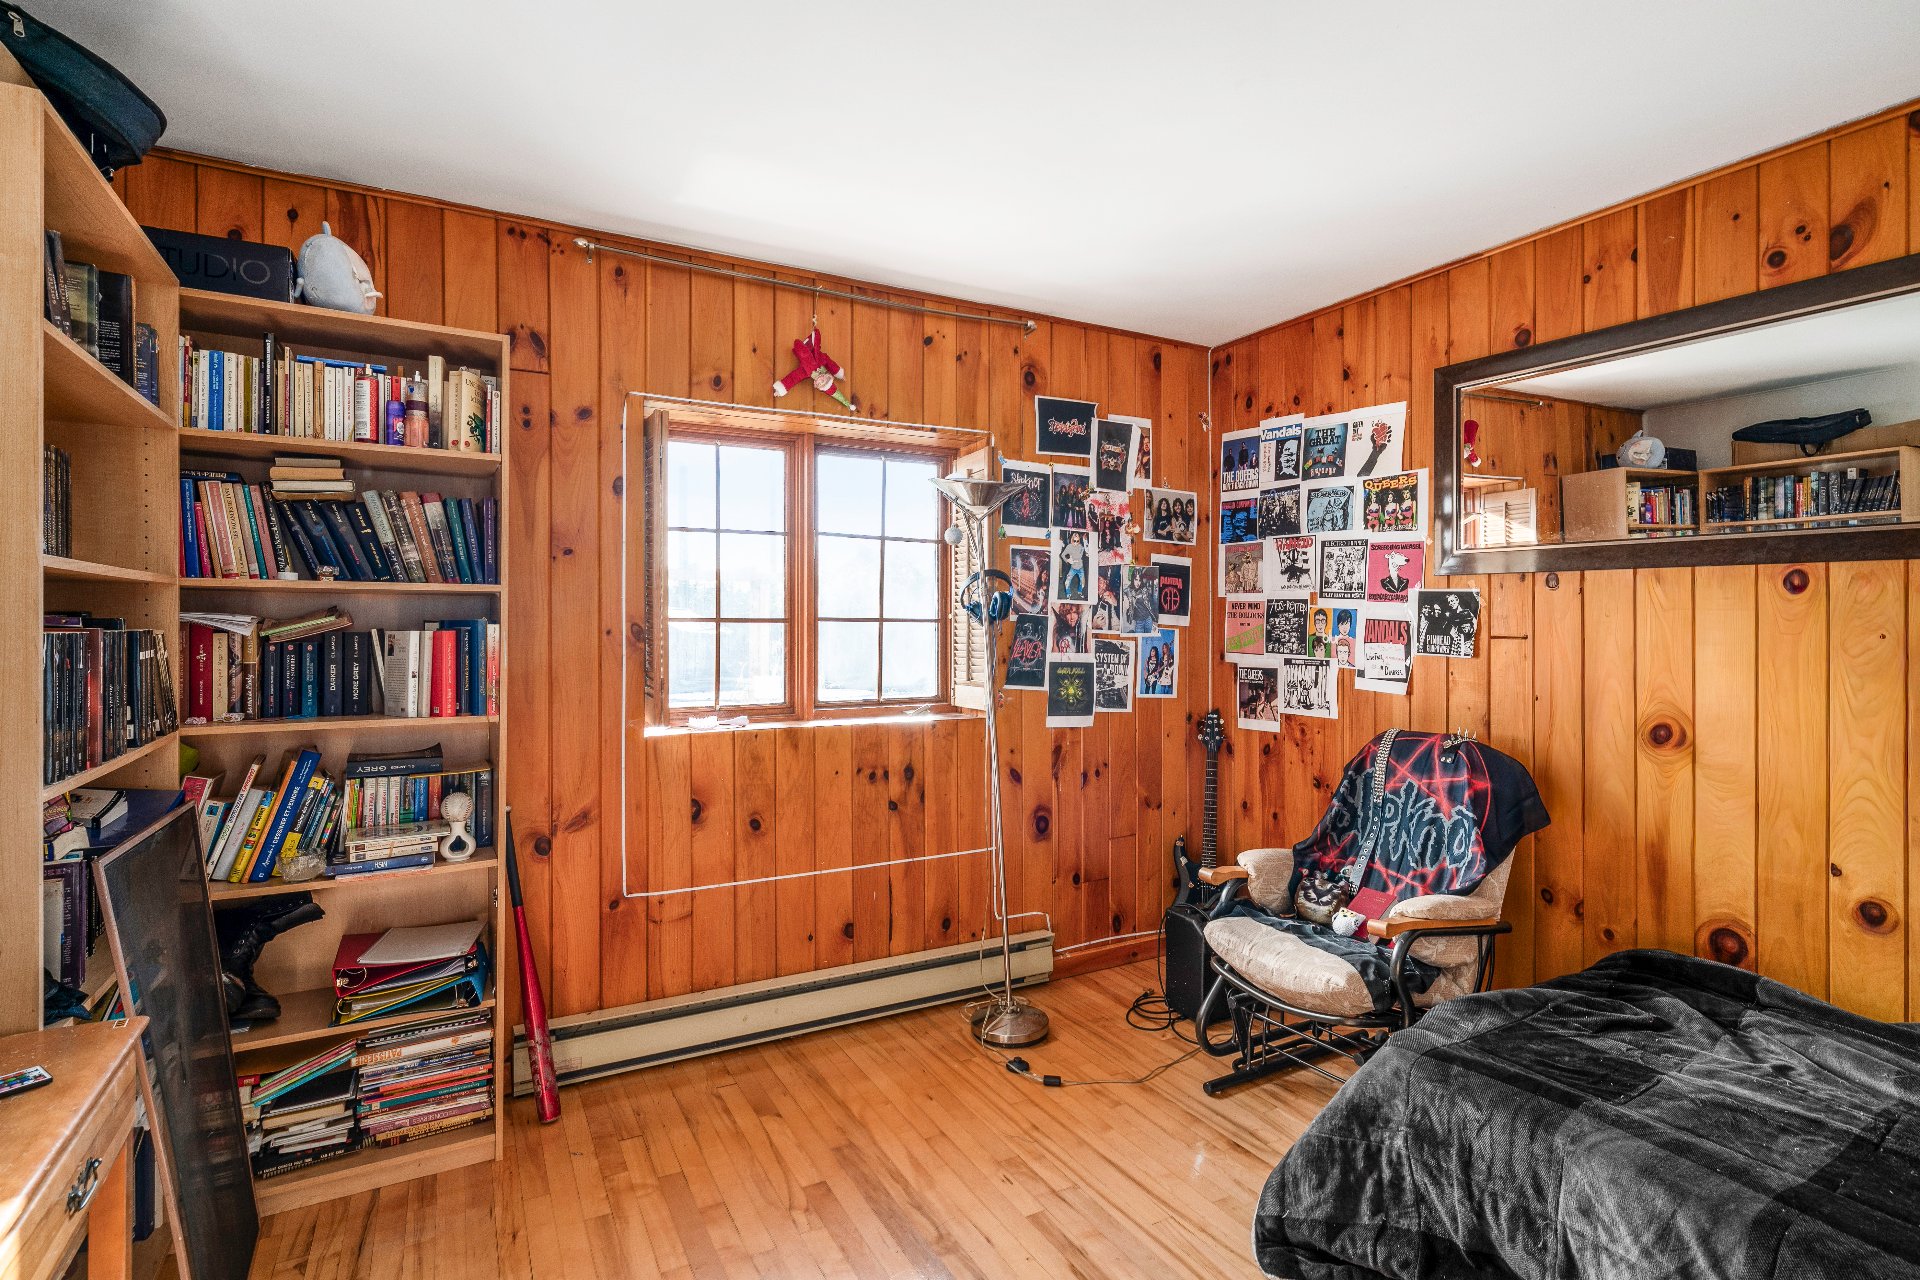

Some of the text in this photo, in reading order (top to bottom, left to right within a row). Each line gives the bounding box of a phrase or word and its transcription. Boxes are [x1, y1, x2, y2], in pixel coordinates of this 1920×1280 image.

[159, 246, 271, 284] TUDIO
[1261, 425, 1302, 440] Vandals
[1315, 428, 1336, 437] THE
[1310, 434, 1342, 446] GREAT
[1222, 470, 1234, 483] THE
[1364, 476, 1417, 491] QUEERS
[1096, 653, 1119, 663] SYSTEM
[356, 765, 387, 773] GREY
